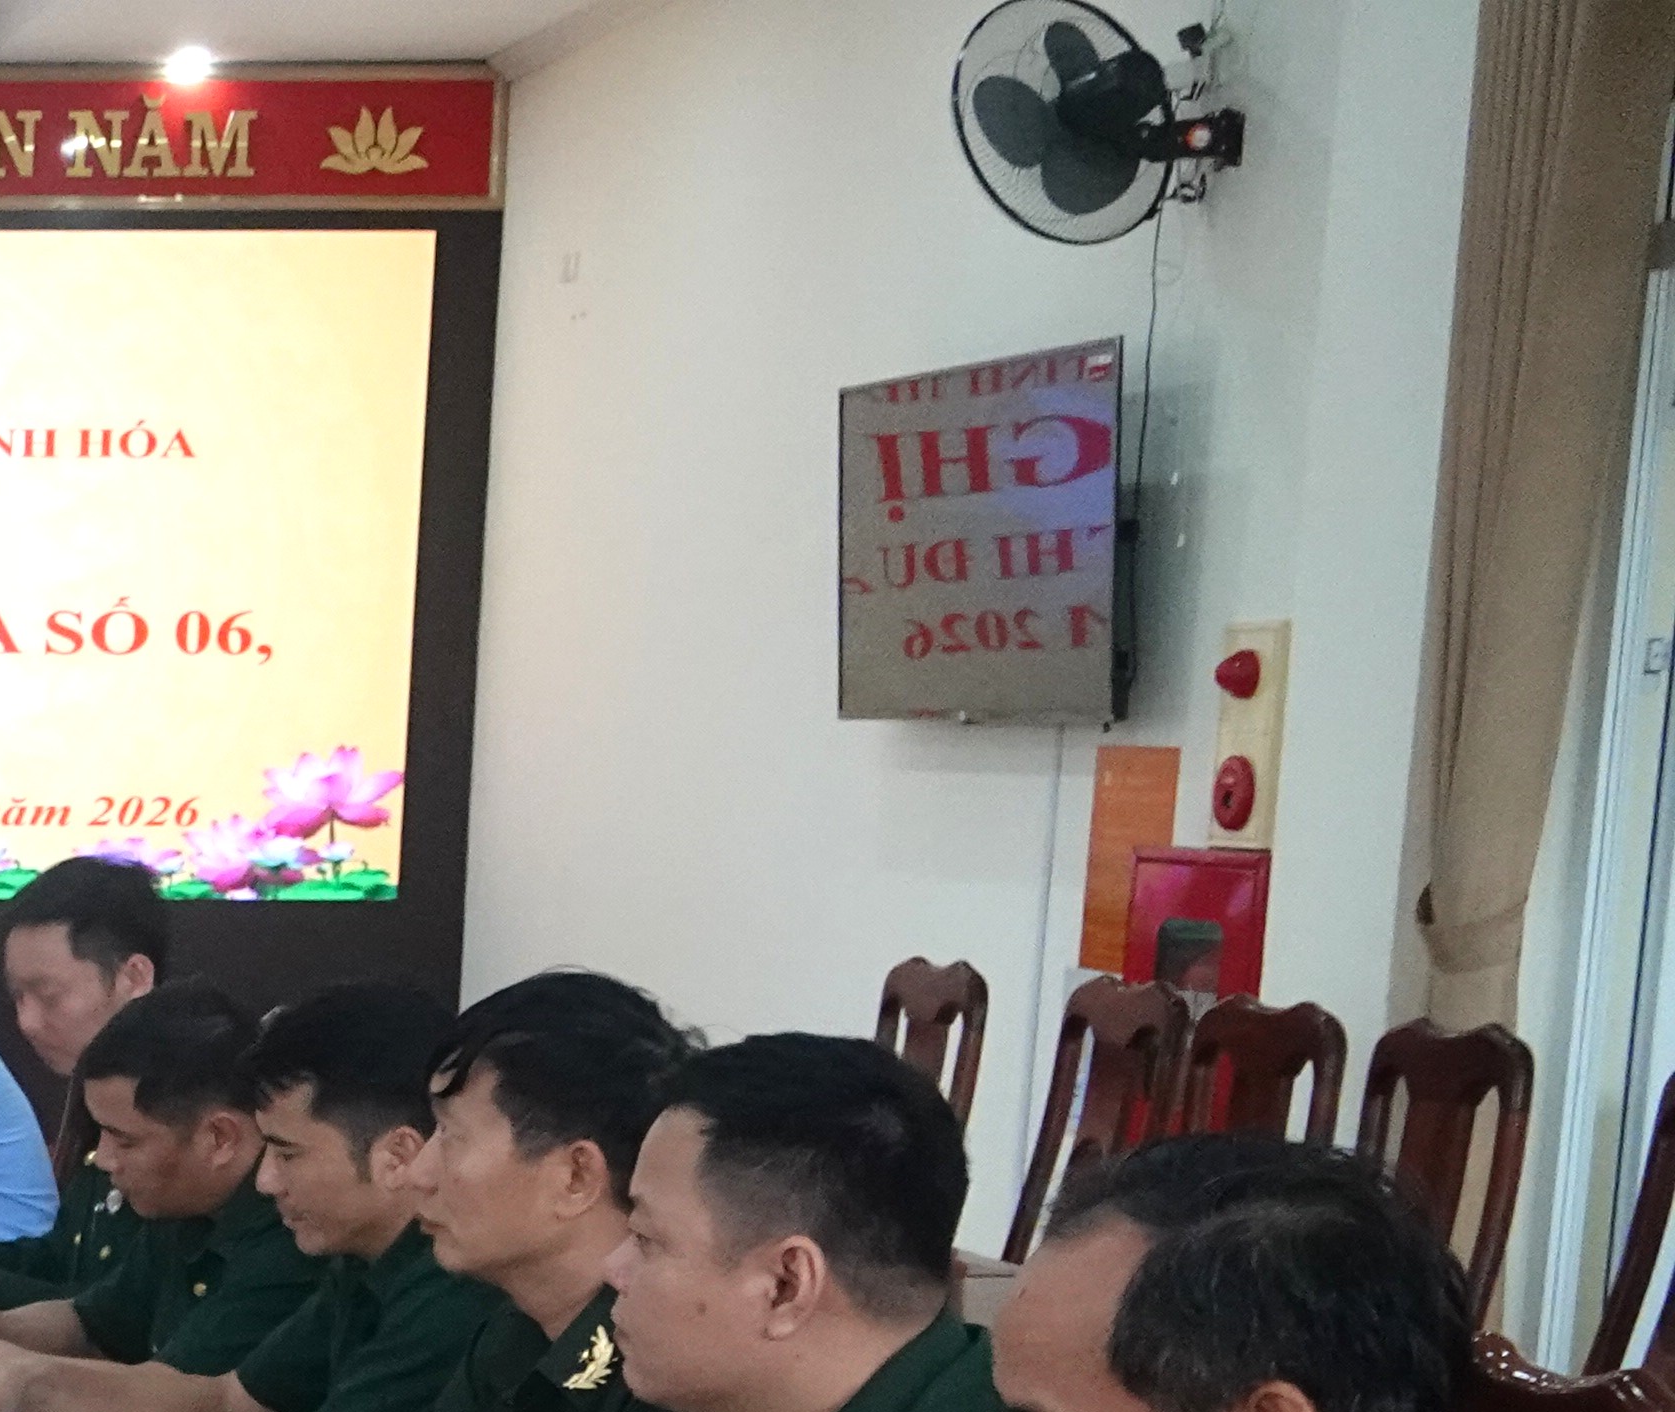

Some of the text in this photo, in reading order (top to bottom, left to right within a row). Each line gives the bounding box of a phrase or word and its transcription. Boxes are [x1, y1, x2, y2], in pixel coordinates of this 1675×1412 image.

[66, 94, 258, 178] NĂM
[77, 419, 197, 459] HÓA
[44, 597, 150, 656] SỐ
[174, 610, 274, 665] 06,
[87, 795, 200, 828] 2026
